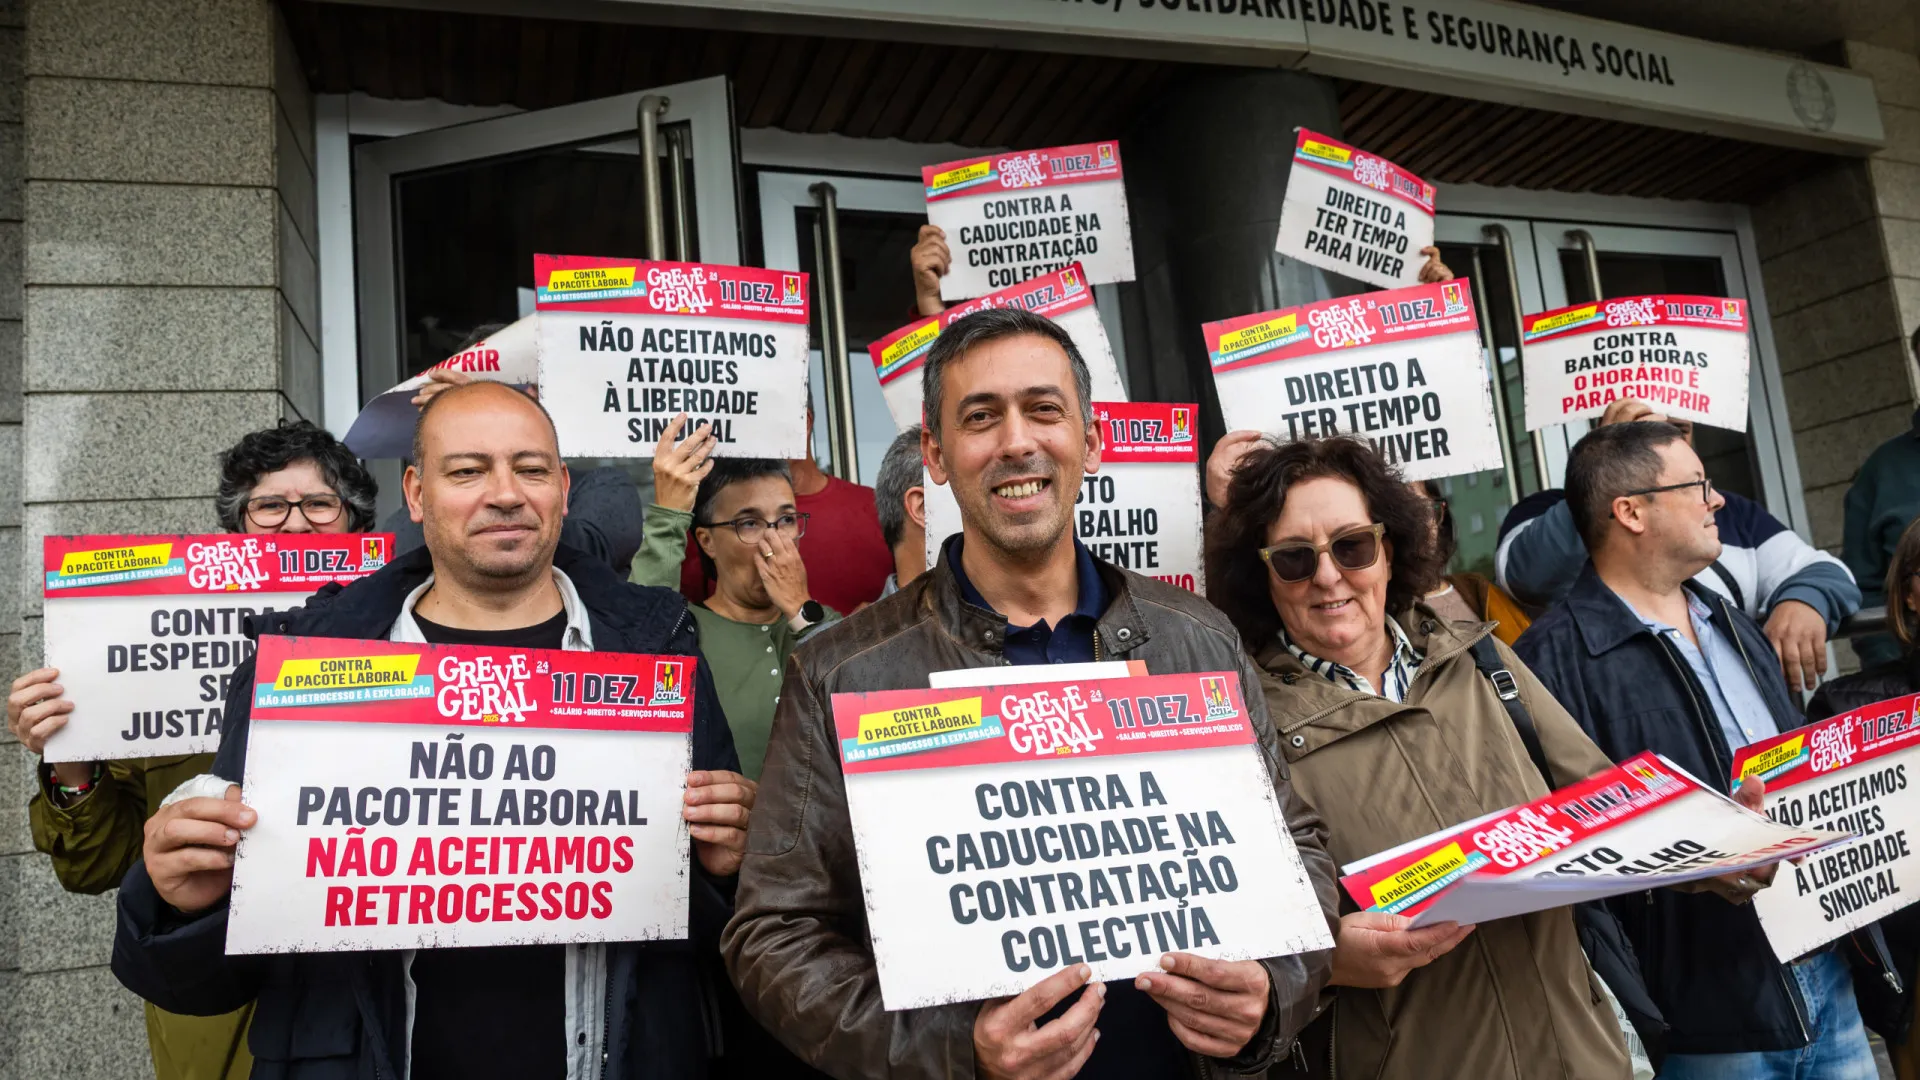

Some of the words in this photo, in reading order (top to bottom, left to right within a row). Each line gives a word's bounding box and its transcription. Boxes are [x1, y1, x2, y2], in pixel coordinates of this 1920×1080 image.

[1403, 6, 1419, 41] E
[1431, 13, 1586, 75] SEGURANÇA
[1593, 43, 1675, 86] SOCIAL
[998, 153, 1040, 173] GREVE
[1001, 166, 1047, 188] GERAL
[1050, 158, 1063, 173] 11
[1065, 155, 1096, 172] DEZ.
[983, 197, 1056, 219] CONTRA
[1060, 194, 1073, 211] A
[1326, 186, 1392, 224] DIREITO
[1394, 211, 1405, 230] A
[960, 216, 1073, 245] CADUCIDADE
[1076, 213, 1101, 232] NA
[1316, 207, 1348, 236] TER
[1352, 219, 1409, 254] TEMPO
[968, 232, 1098, 267] CONTRATAÇÃO
[1305, 230, 1351, 262] PARA
[1356, 246, 1404, 278] VIVER
[560, 279, 591, 289] PACOTE
[592, 278, 629, 287] LABORAL
[574, 270, 607, 280] CONTRA
[647, 267, 707, 293] GREVE
[649, 286, 713, 314] GERAL
[720, 280, 736, 301] 11
[739, 281, 779, 304] DEZ.
[1023, 285, 1062, 310] DEZ.
[1308, 299, 1366, 330] GREVE
[1378, 304, 1398, 326] 11
[1398, 297, 1442, 323] DEZ.
[1605, 298, 1654, 316] GREVE
[1607, 308, 1661, 327] GERAL
[1666, 303, 1680, 316] 11
[1683, 304, 1720, 319] DEZ.
[580, 320, 633, 352] NÃO
[640, 328, 776, 359] ACEITAMOS
[1223, 344, 1229, 352] O
[1230, 336, 1257, 351] PACOTE
[1259, 325, 1293, 341] LABORAL
[1240, 324, 1271, 338] CONTRA
[1313, 312, 1376, 349] GERAL
[1593, 332, 1678, 351] CONTRA
[626, 357, 739, 385] ATAQUES
[1565, 350, 1634, 374] BANCO
[1640, 348, 1708, 368] HORAS
[1284, 361, 1399, 406] DIREITO
[1407, 357, 1427, 388] A
[1574, 375, 1587, 391] O
[1592, 363, 1684, 388] HORÁRIO
[1689, 366, 1699, 389] É
[603, 381, 621, 413] À
[627, 388, 759, 415] LIBERDADE
[1562, 388, 1616, 415] PARA
[1622, 385, 1711, 414] CUMPRIR
[1110, 419, 1127, 443] 11
[1129, 419, 1168, 443] DEZ.
[1281, 407, 1339, 443] TER
[1343, 392, 1442, 440] TEMPO
[67, 564, 74, 574] O
[76, 561, 115, 573] PACOTE
[117, 556, 164, 567] LABORAL
[94, 549, 135, 561] CONTRA
[187, 538, 262, 567] GREVE
[278, 549, 299, 574] 11
[304, 549, 356, 573] DEZ.
[187, 559, 270, 591] GERAL
[284, 676, 292, 687] O
[296, 673, 345, 686] PACOTE
[349, 670, 407, 684] LABORAL
[320, 659, 372, 672] CONTRA
[437, 654, 531, 691] GREVE
[536, 660, 549, 669] 24
[259, 695, 279, 706] NÃO
[281, 694, 294, 704] AO
[296, 688, 355, 703] RETROCESSO
[357, 689, 363, 699] E
[364, 686, 371, 698] À
[373, 685, 431, 699] EXPLORAÇÃO
[437, 682, 538, 723] GERAL
[551, 672, 578, 703] 11
[582, 673, 645, 705] DEZ.
[1090, 689, 1102, 698] 24
[482, 714, 499, 723] 2025
[550, 707, 583, 716] +SALÁRIO
[583, 708, 616, 717] +DIREITOS
[617, 709, 652, 719] +SERVIÇOS
[653, 707, 685, 719] PÚBLICOS
[893, 706, 942, 723] CONTRA
[1000, 685, 1088, 724] GREVE
[1107, 698, 1136, 729] 11
[1136, 694, 1202, 728] DEZ.
[121, 708, 223, 741] JUSTA
[864, 730, 873, 741] O
[875, 722, 921, 739] PACOTE
[923, 714, 977, 733] LABORAL
[1008, 712, 1104, 756] GERAL
[1116, 731, 1147, 741] +SALÁRIO
[1179, 726, 1212, 738] +SERVIÇOS
[1212, 723, 1244, 733] PÚBLICOS
[1811, 716, 1853, 749] GREVE
[1862, 719, 1874, 743] 11
[1877, 710, 1908, 739] DEZ.
[409, 732, 494, 781] NÃO
[503, 744, 556, 781] AO
[847, 749, 866, 761] NÃO
[880, 738, 933, 756] RETROCESSO
[934, 736, 940, 746] E
[948, 727, 1001, 744] EXPLORAÇÃO
[1760, 746, 1783, 762] CONTRA
[1811, 735, 1857, 772] GERAL
[296, 787, 462, 826] PACOTE
[470, 788, 648, 826] LABORAL
[974, 773, 1133, 821] CONTRA
[1139, 771, 1168, 806] A
[1808, 764, 1907, 822] ACEITAMOS
[925, 815, 1175, 875] CADUCIDADE
[1176, 810, 1236, 849] NA
[1473, 807, 1547, 851] GREVE
[305, 827, 398, 877] NÃO
[406, 835, 635, 876] ACEITAMOS
[1490, 821, 1574, 867] GERAL
[1395, 861, 1432, 884] CONTRA
[1809, 830, 1910, 890] LIBERDADE
[949, 848, 1239, 926] CONTRATAÇÃO
[1379, 895, 1389, 904] O
[1819, 868, 1900, 922] SINDICAL
[324, 880, 613, 927] RETROCESSOS
[1000, 906, 1221, 974] COLECTIVA
